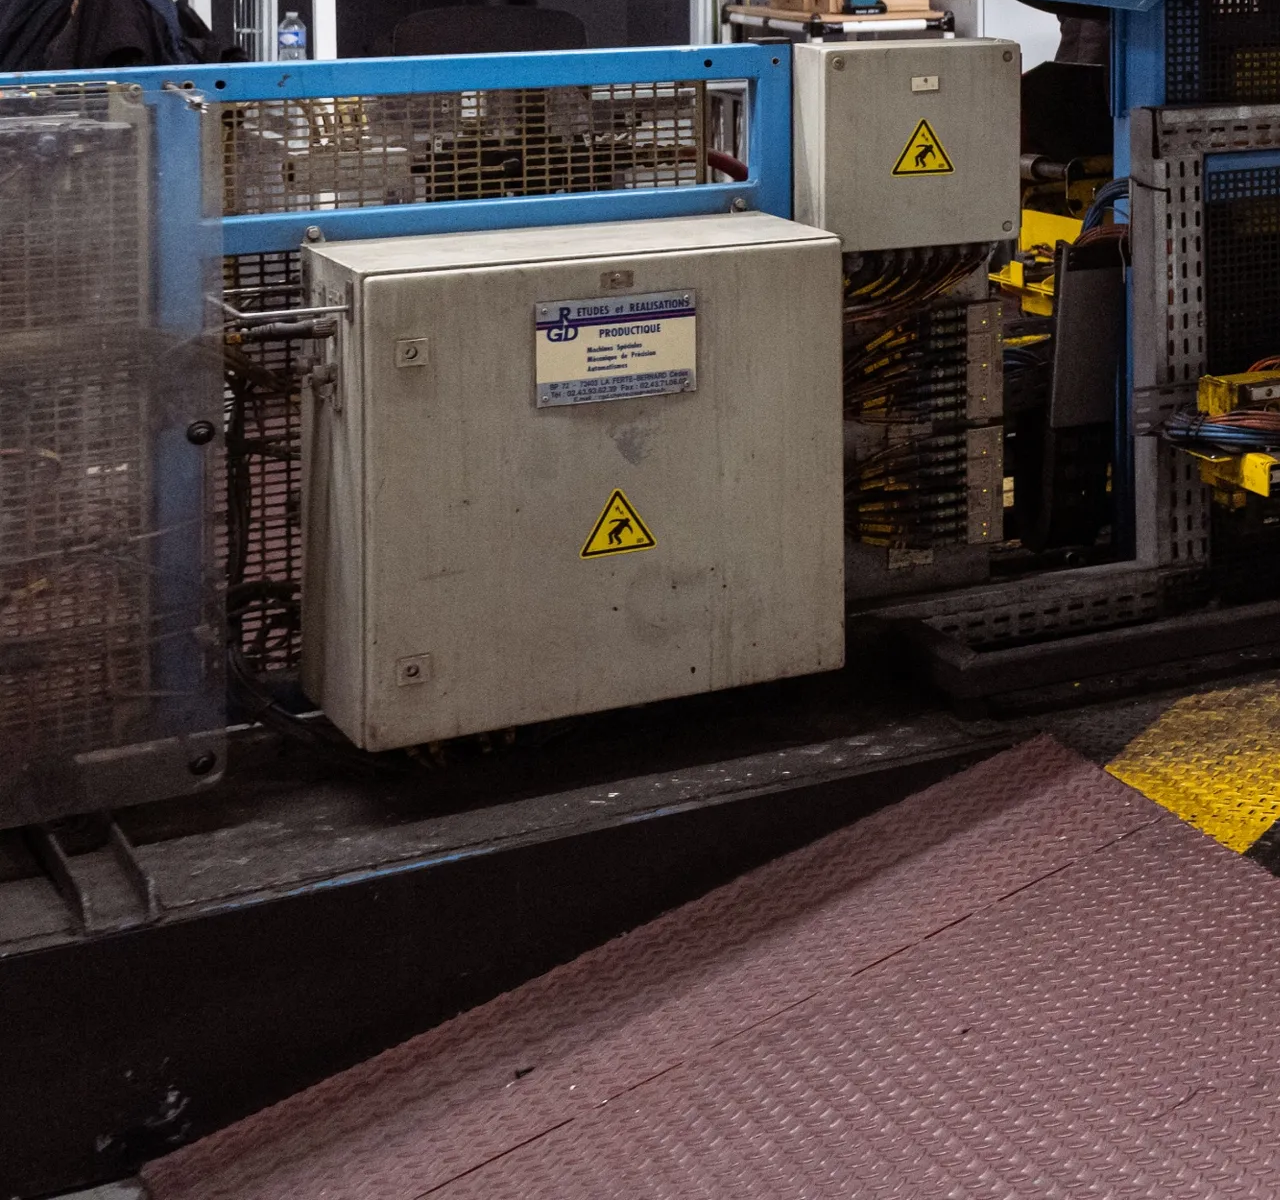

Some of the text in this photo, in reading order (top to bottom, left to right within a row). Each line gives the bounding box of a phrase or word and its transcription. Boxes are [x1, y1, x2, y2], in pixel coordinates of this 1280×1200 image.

[577, 299, 690, 318] ETUDES et REALISATIONS
[599, 324, 661, 338] PRODUCTIQUE
[586, 345, 614, 354] Machines
[620, 352, 628, 360] de
[600, 378, 610, 386] LA
